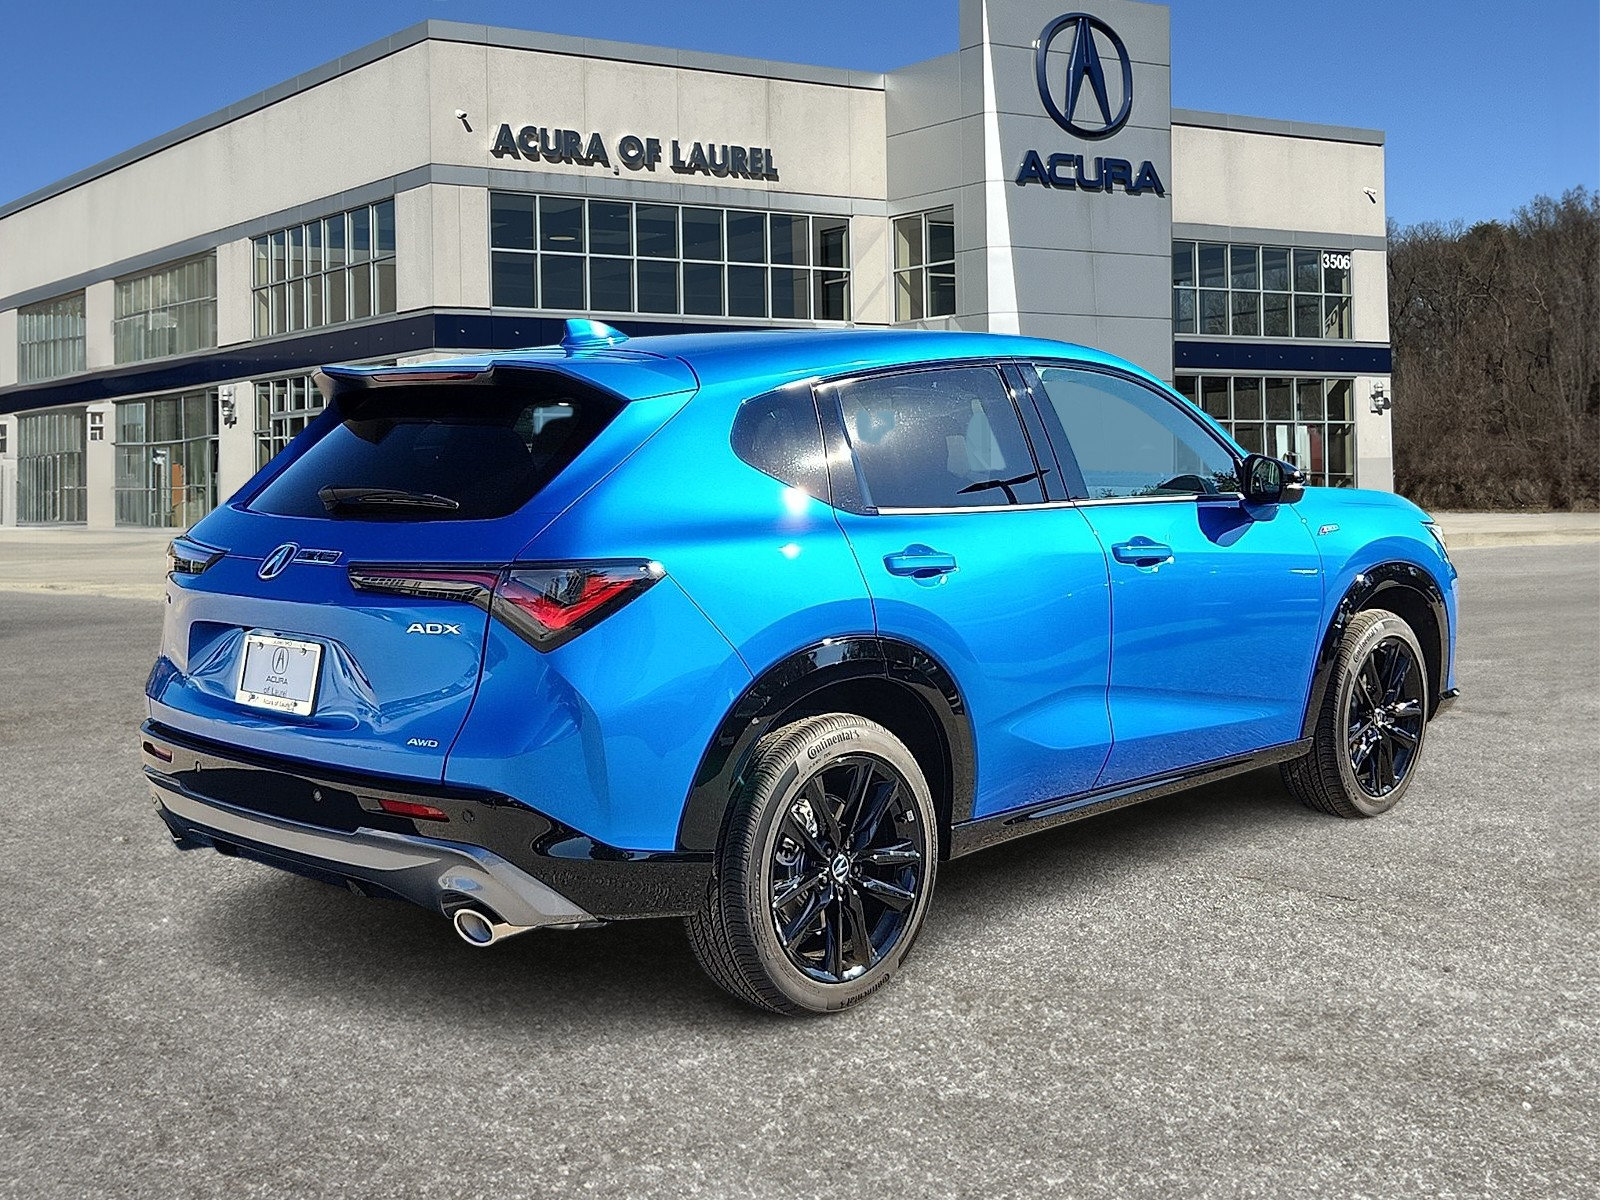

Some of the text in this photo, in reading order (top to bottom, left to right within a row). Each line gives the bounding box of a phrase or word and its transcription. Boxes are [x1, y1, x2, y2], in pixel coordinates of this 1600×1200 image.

[491, 123, 779, 181] ACURA OF LAUREL
[1015, 149, 1165, 197] ACURA
[1322, 253, 1351, 270] 3506
[406, 622, 461, 635] ADX
[265, 675, 289, 685] ACURA
[406, 738, 439, 748] AWD
[807, 729, 854, 760] Continental
